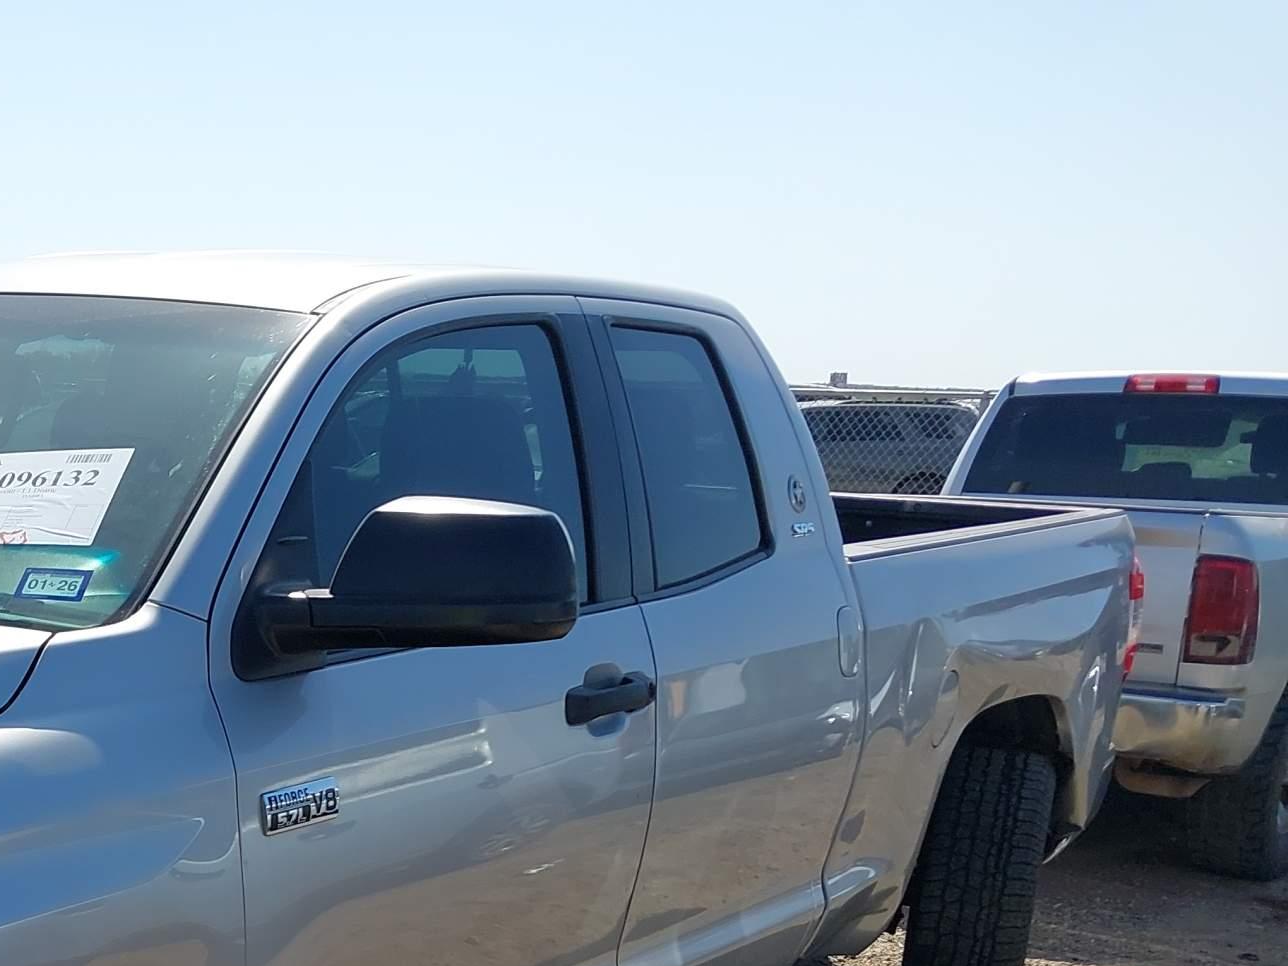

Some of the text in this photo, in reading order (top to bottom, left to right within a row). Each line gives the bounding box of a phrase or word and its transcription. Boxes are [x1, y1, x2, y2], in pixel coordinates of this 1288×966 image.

[27, 578, 79, 592] 01 26
[311, 787, 339, 815] V8
